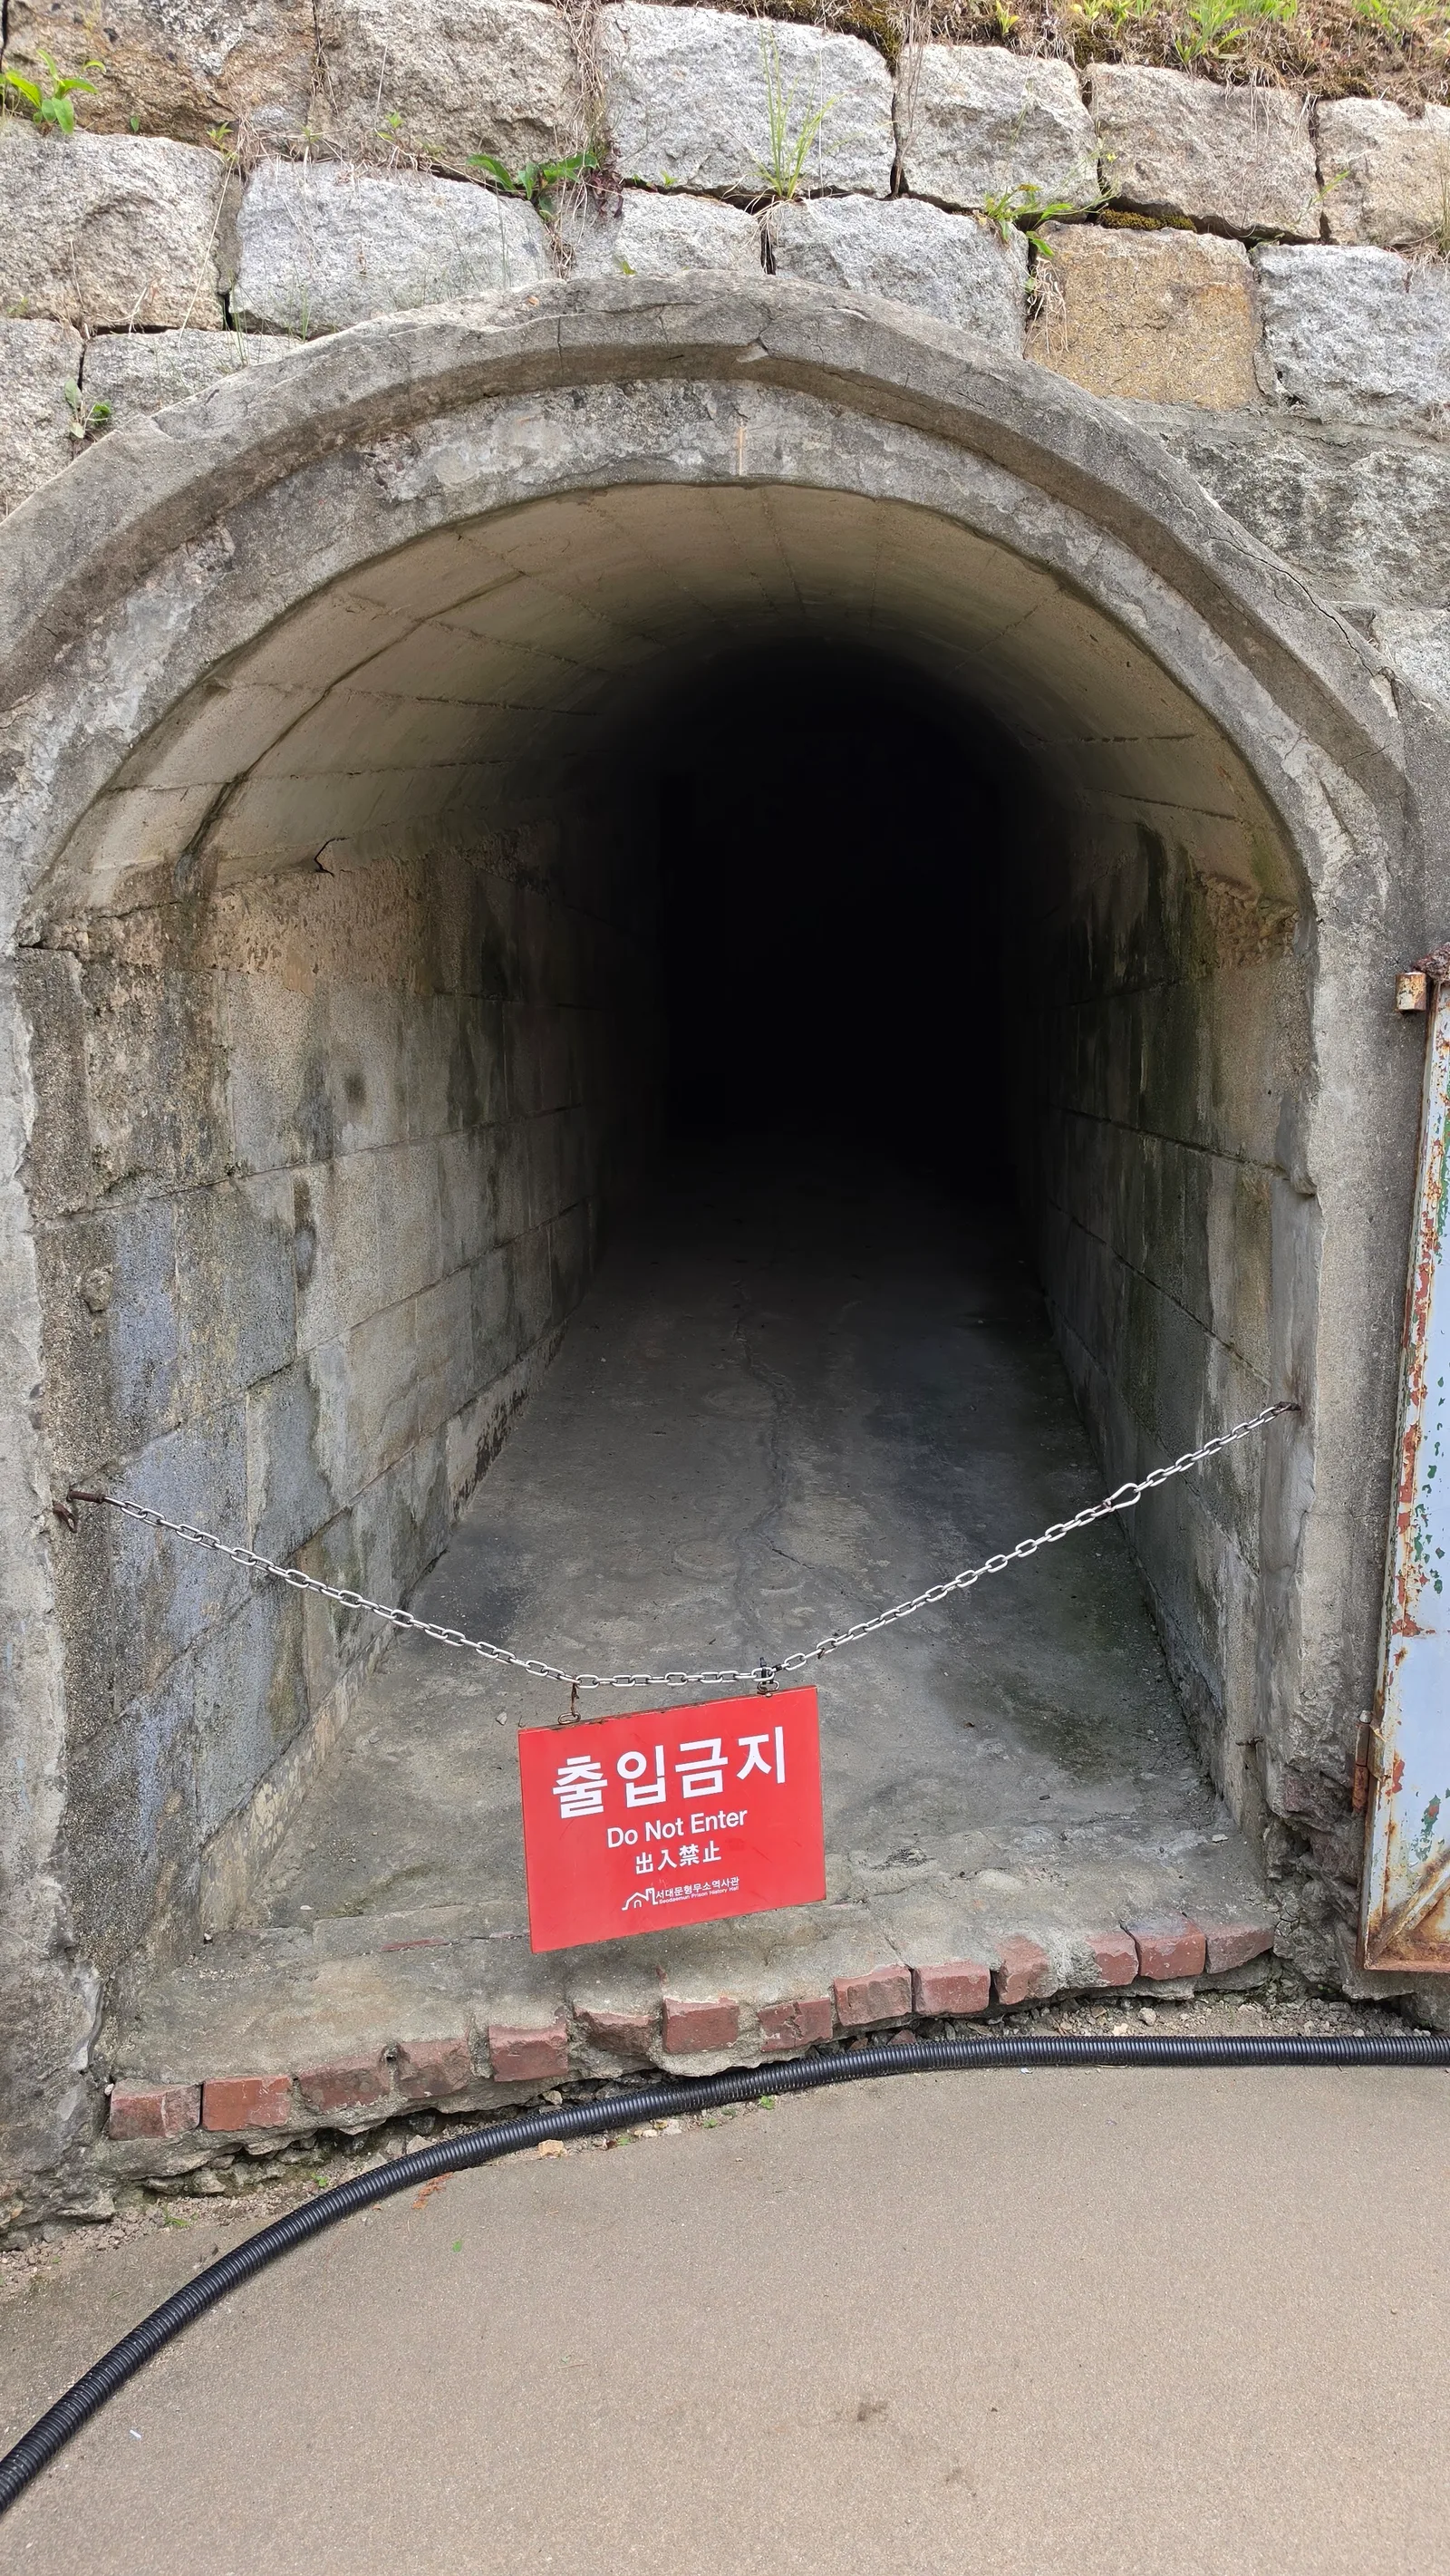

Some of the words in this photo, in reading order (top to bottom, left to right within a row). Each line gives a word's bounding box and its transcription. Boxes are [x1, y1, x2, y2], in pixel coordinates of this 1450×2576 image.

[553, 1726, 787, 1819] 출입금지
[607, 1826, 639, 1848] Do
[644, 1818, 684, 1842] Not
[691, 1810, 748, 1835] Enter
[635, 1841, 721, 1874] 出入禁止
[655, 1876, 740, 1899] 서대문형무소역사관
[659, 1894, 691, 1904] Seodaemun
[691, 1891, 708, 1899] Prison
[710, 1888, 728, 1896] History
